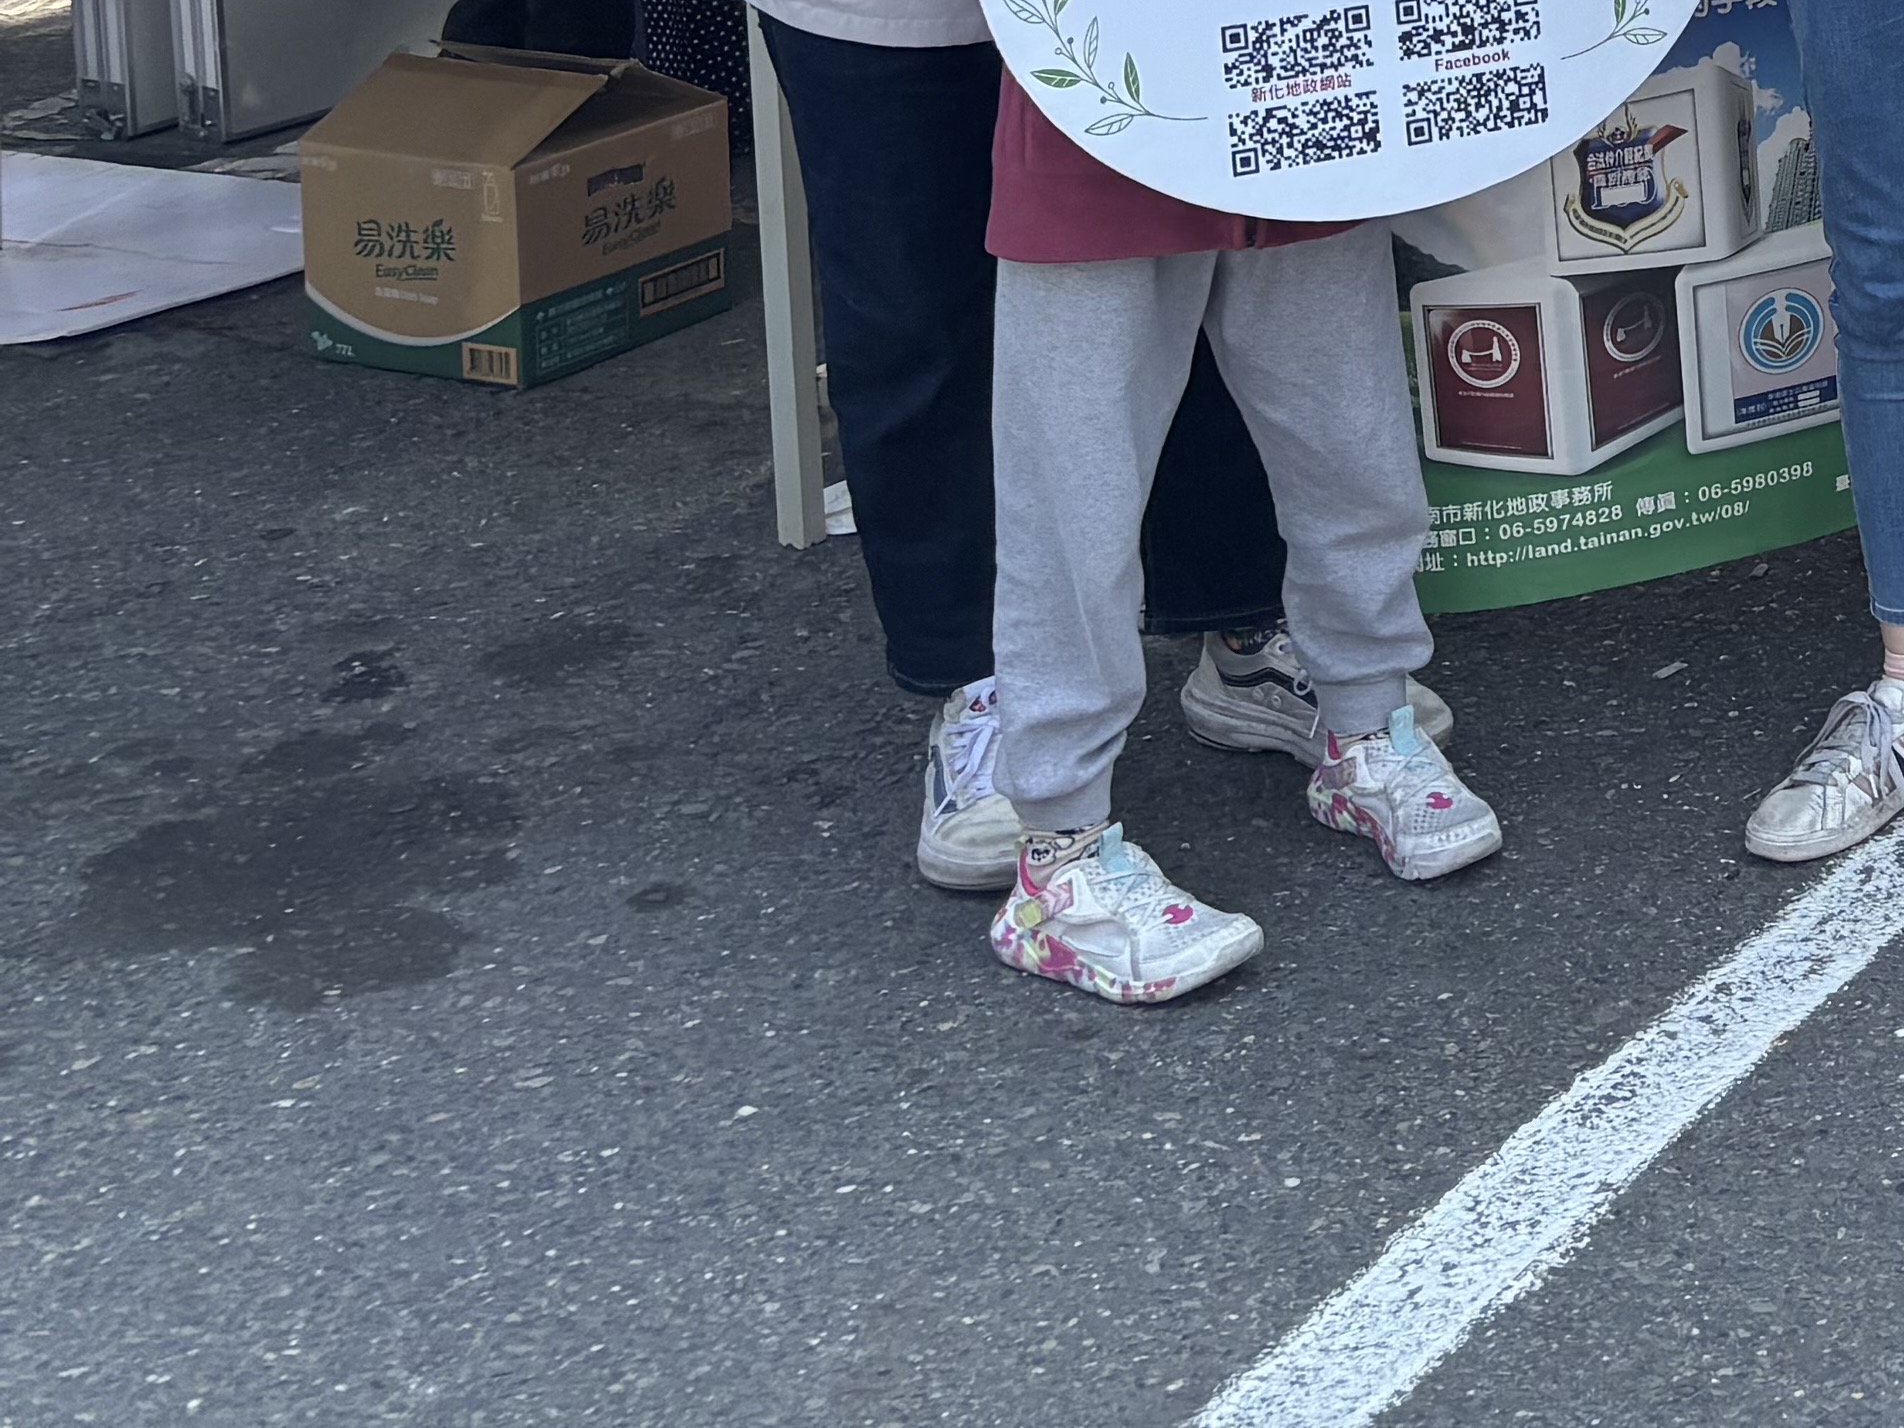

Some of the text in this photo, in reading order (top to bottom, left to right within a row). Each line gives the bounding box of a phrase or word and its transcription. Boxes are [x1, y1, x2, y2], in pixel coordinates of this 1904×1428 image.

[1433, 48, 1513, 73] Facebook
[1250, 71, 1355, 105] 新化地政網站
[581, 175, 677, 248] 易洗樂
[354, 217, 457, 263] 易洗樂
